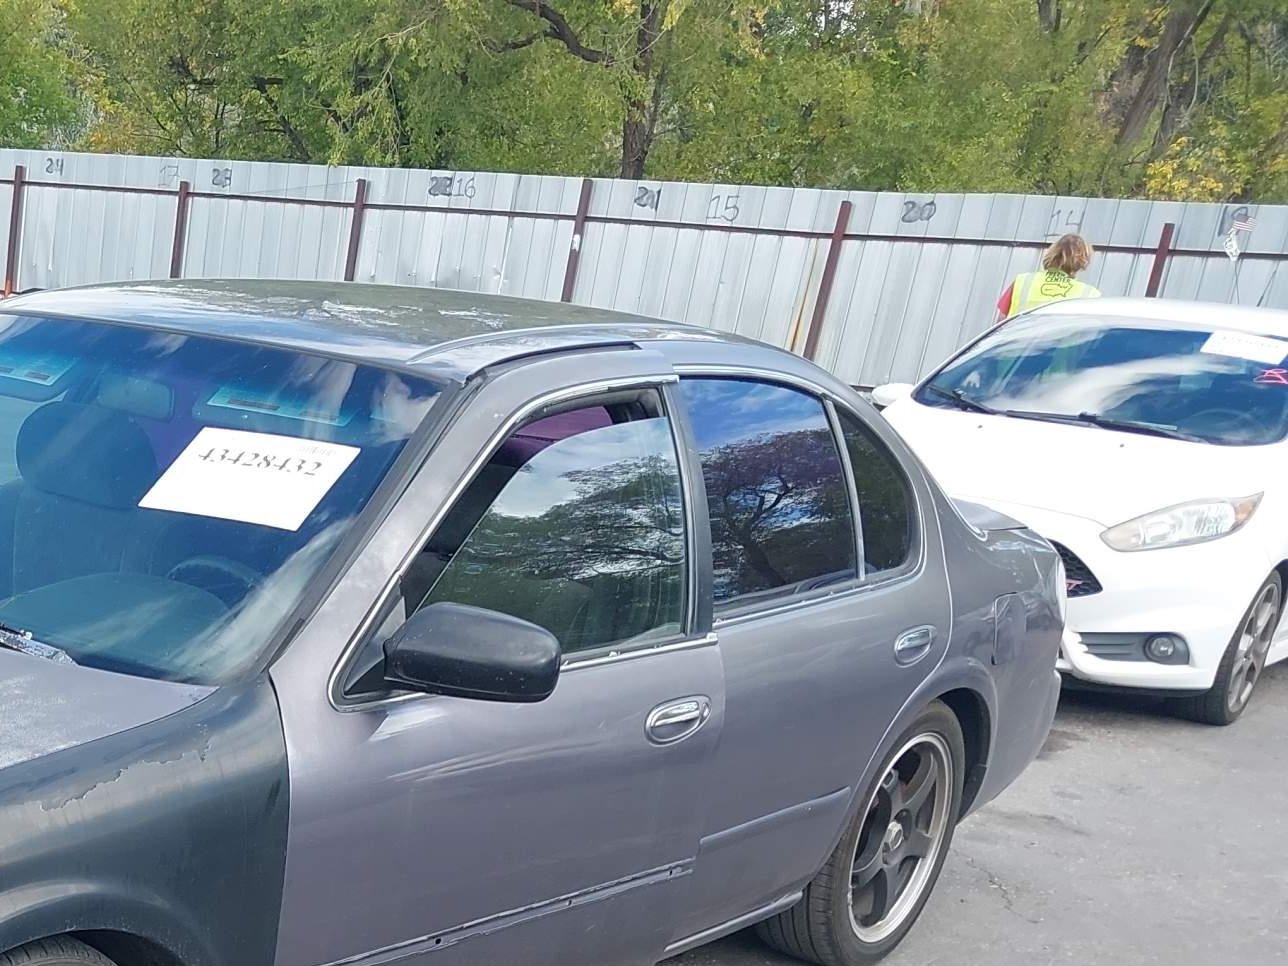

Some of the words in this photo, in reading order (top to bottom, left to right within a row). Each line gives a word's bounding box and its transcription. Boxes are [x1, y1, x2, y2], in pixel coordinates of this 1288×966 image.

[45, 157, 64, 176] 24
[453, 176, 476, 198] 16
[706, 195, 740, 222] 15
[901, 200, 937, 223] 20
[198, 448, 322, 476] 43428432
